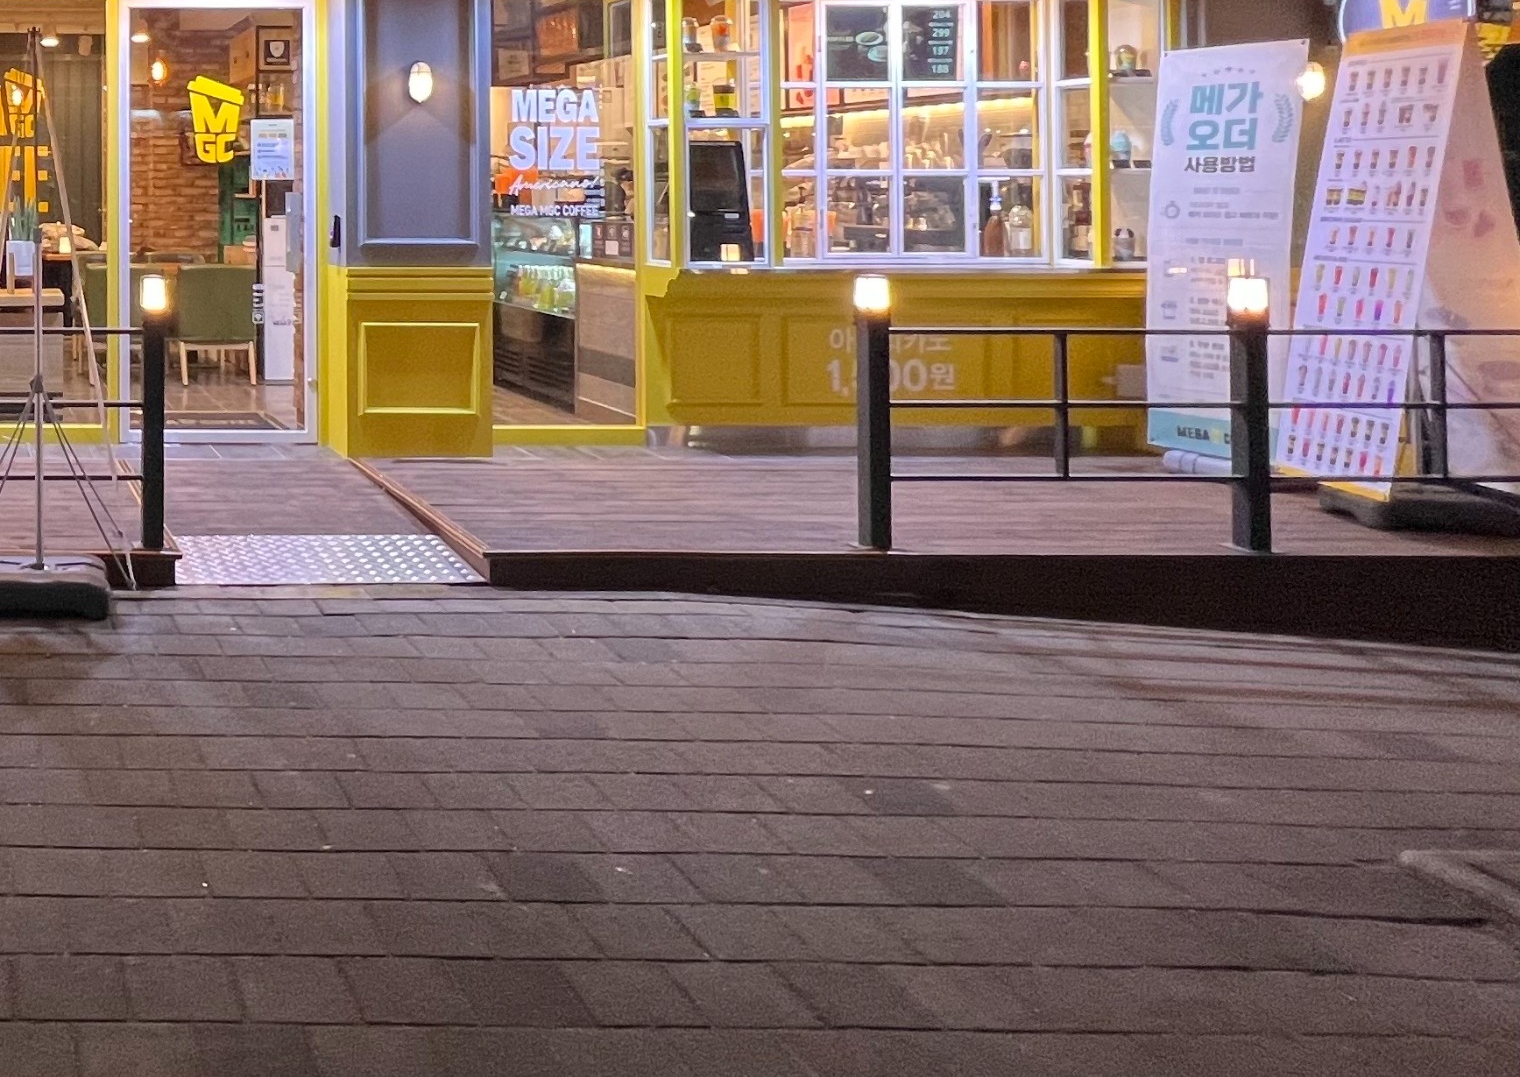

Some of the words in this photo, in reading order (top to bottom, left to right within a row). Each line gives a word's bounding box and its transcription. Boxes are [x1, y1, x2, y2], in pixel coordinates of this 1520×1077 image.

[511, 88, 600, 123] MEGA
[1189, 81, 1264, 116] 메가
[509, 125, 601, 171] SIZE
[1186, 117, 1259, 151] 오더
[1183, 156, 1256, 174] 사용방법
[510, 204, 538, 217] MEGA
[562, 204, 599, 217] COFFEE
[828, 327, 953, 354] 아카노
